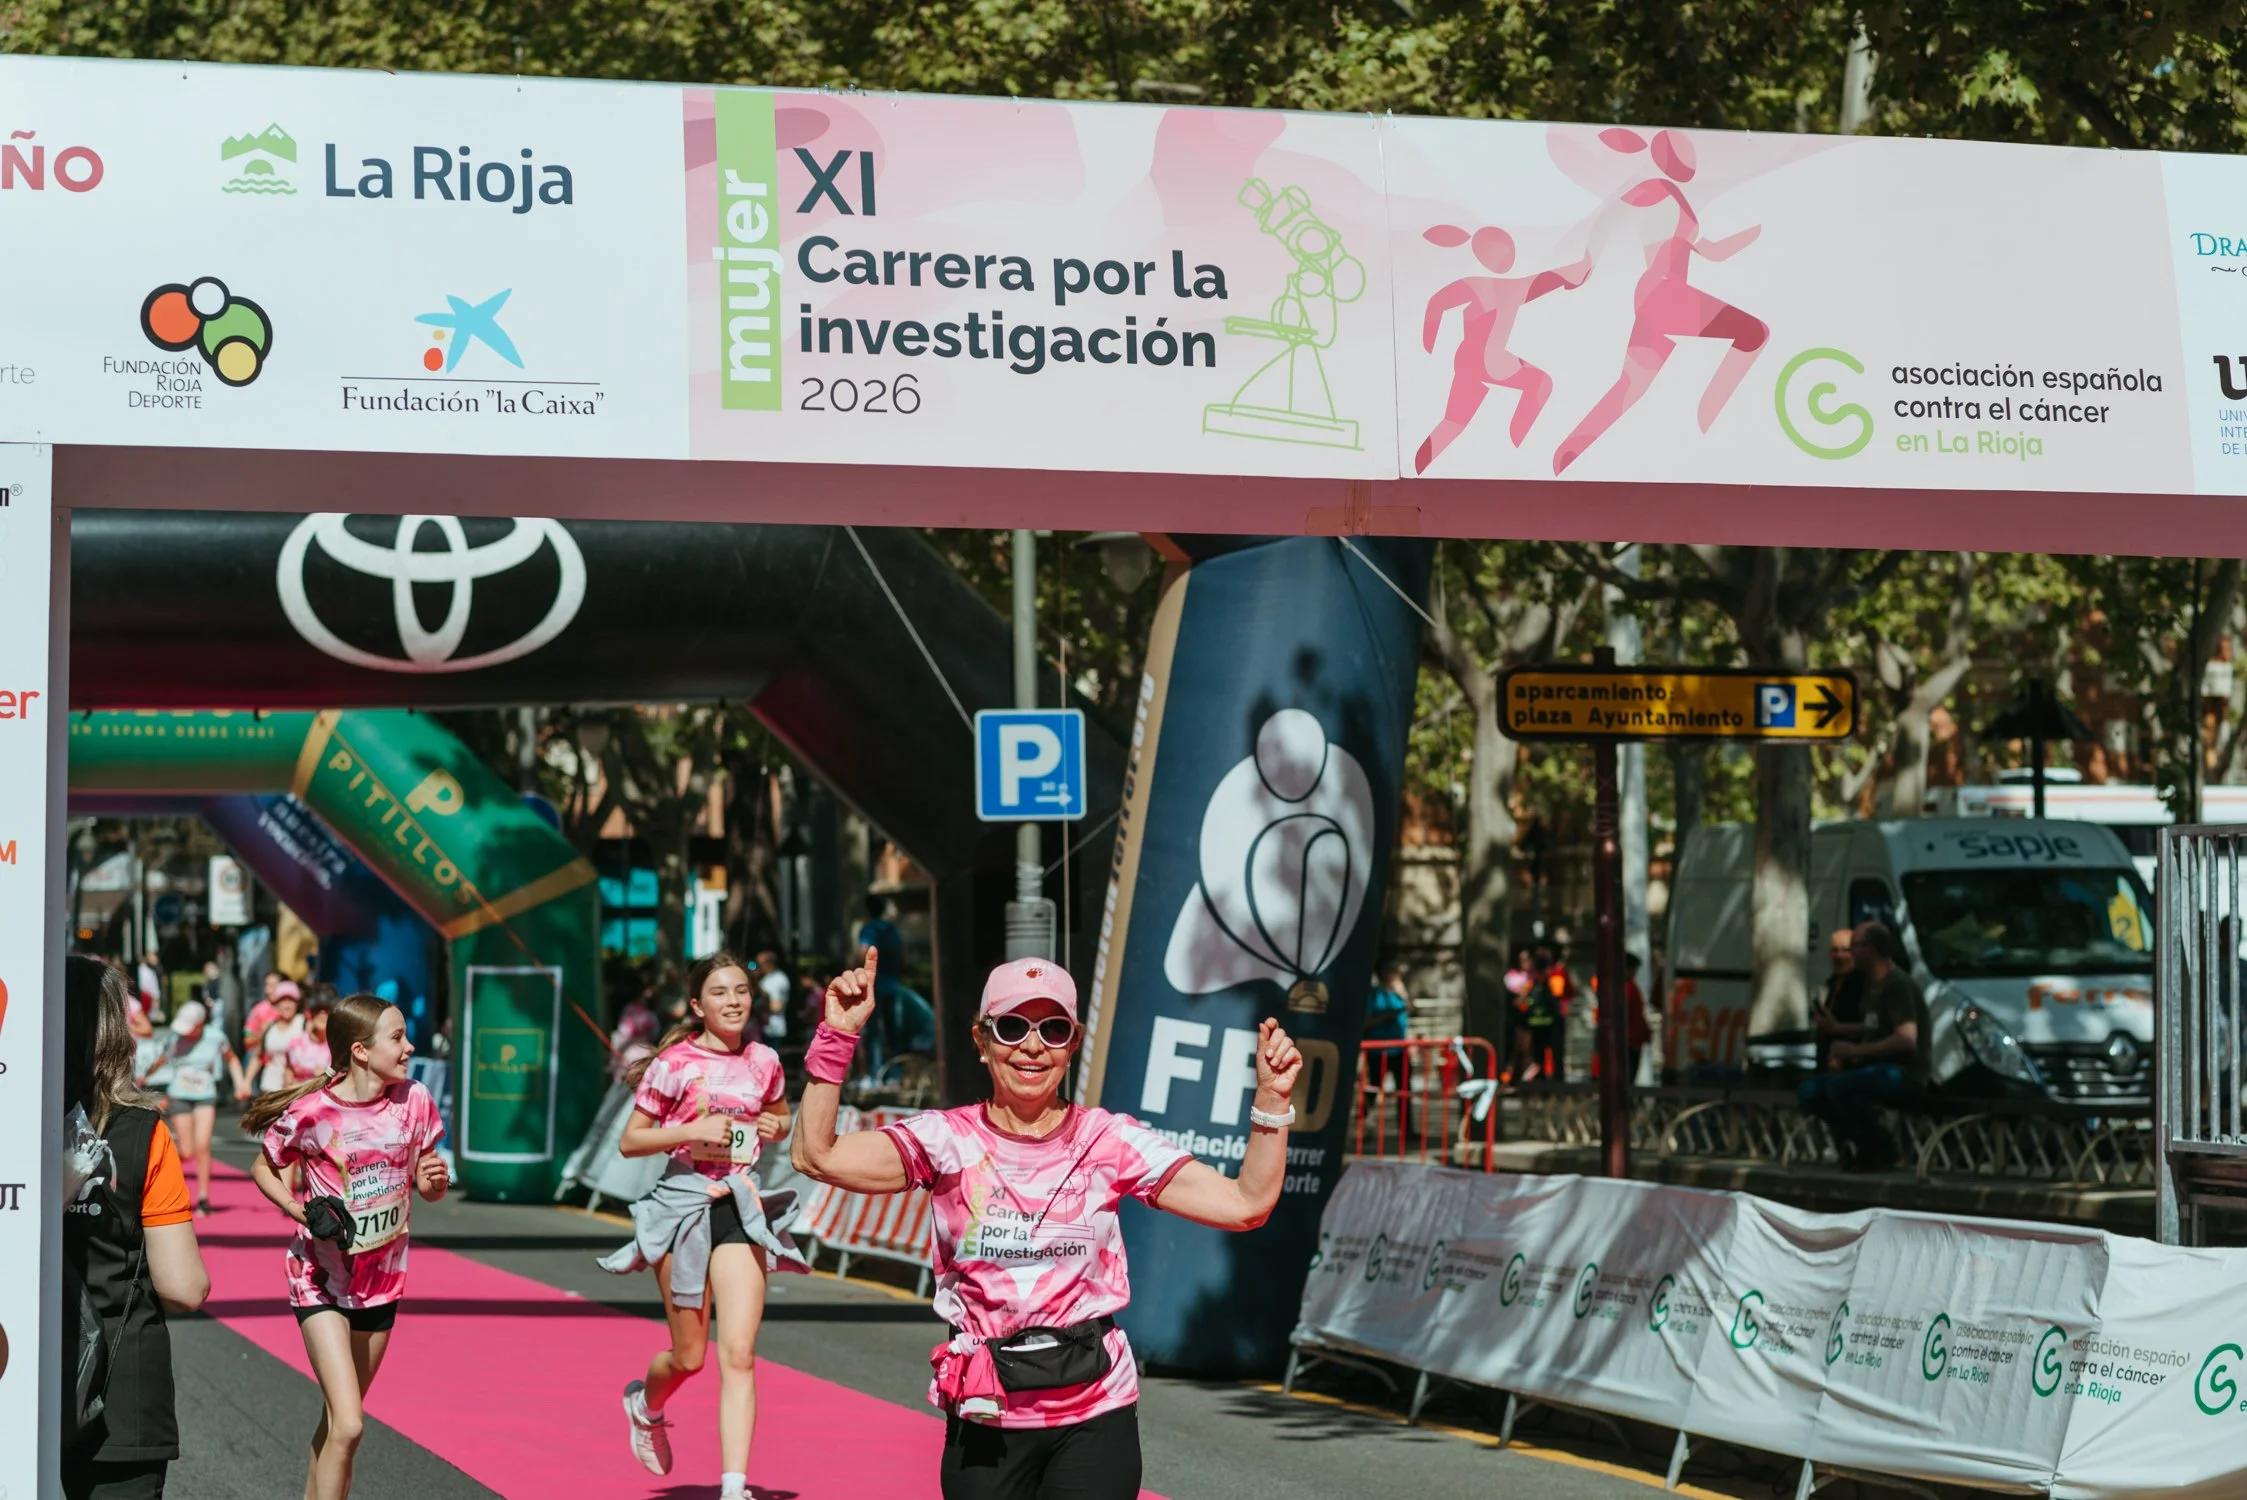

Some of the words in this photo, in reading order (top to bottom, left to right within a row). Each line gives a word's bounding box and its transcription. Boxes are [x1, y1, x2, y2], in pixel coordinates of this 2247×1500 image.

[325, 143, 393, 199] La
[413, 145, 573, 214] Rioja
[793, 147, 876, 216] XI
[712, 169, 784, 382] mujer
[797, 235, 1035, 292] Carrera
[1053, 257, 1156, 306] por
[1172, 249, 1228, 300] la
[800, 303, 1216, 375] investigación
[1892, 362, 2034, 388] asociación
[2042, 368, 2163, 395] española
[341, 386, 479, 413] Fundación
[800, 373, 921, 414] 2026
[1894, 396, 1981, 419] contra
[1988, 397, 2011, 420] el
[2019, 398, 2110, 423] cáncer
[1896, 433, 1929, 453] en
[1937, 429, 1969, 454] La
[1977, 430, 2043, 462] Rioja
[2222, 443, 2240, 455] DE
[1514, 708, 1572, 727] plaza
[1588, 706, 1744, 729] Ayuntamiento
[1761, 687, 1789, 726] P
[1000, 724, 1062, 807] P
[347, 1160, 388, 1176] Carrera
[351, 1177, 367, 1191] por
[990, 1185, 1007, 1199] XI
[358, 1206, 400, 1237] 7170
[986, 1203, 1046, 1222] Carrera
[981, 1225, 1011, 1240] por
[1013, 1226, 1028, 1240] la
[980, 1242, 1088, 1260] Investigación
[1951, 1344, 1980, 1359] contra
[1947, 1366, 1958, 1378] en
[1959, 1364, 1970, 1379] La
[2100, 1362, 2114, 1378] el
[2116, 1364, 2166, 1386] cáncer
[2087, 1382, 2122, 1405] Rioja
